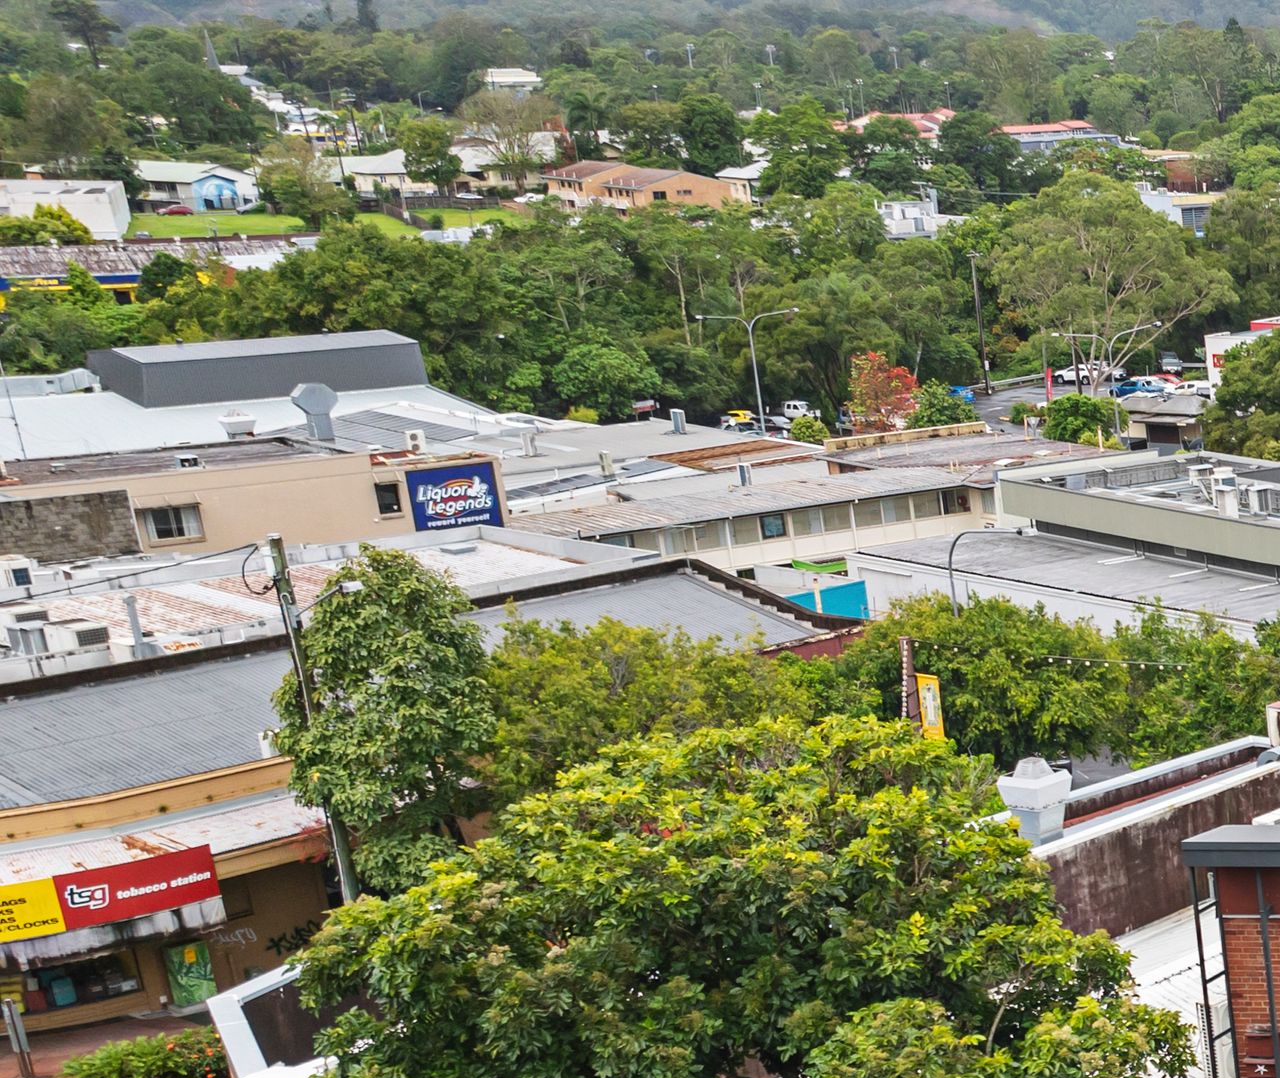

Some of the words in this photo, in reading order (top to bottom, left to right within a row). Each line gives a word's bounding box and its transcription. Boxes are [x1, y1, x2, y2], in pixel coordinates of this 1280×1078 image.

[417, 484, 468, 503] Liquor
[427, 493, 492, 516] Legends
[65, 883, 109, 910] tsg
[116, 881, 168, 900] tobacco
[170, 870, 211, 889] station
